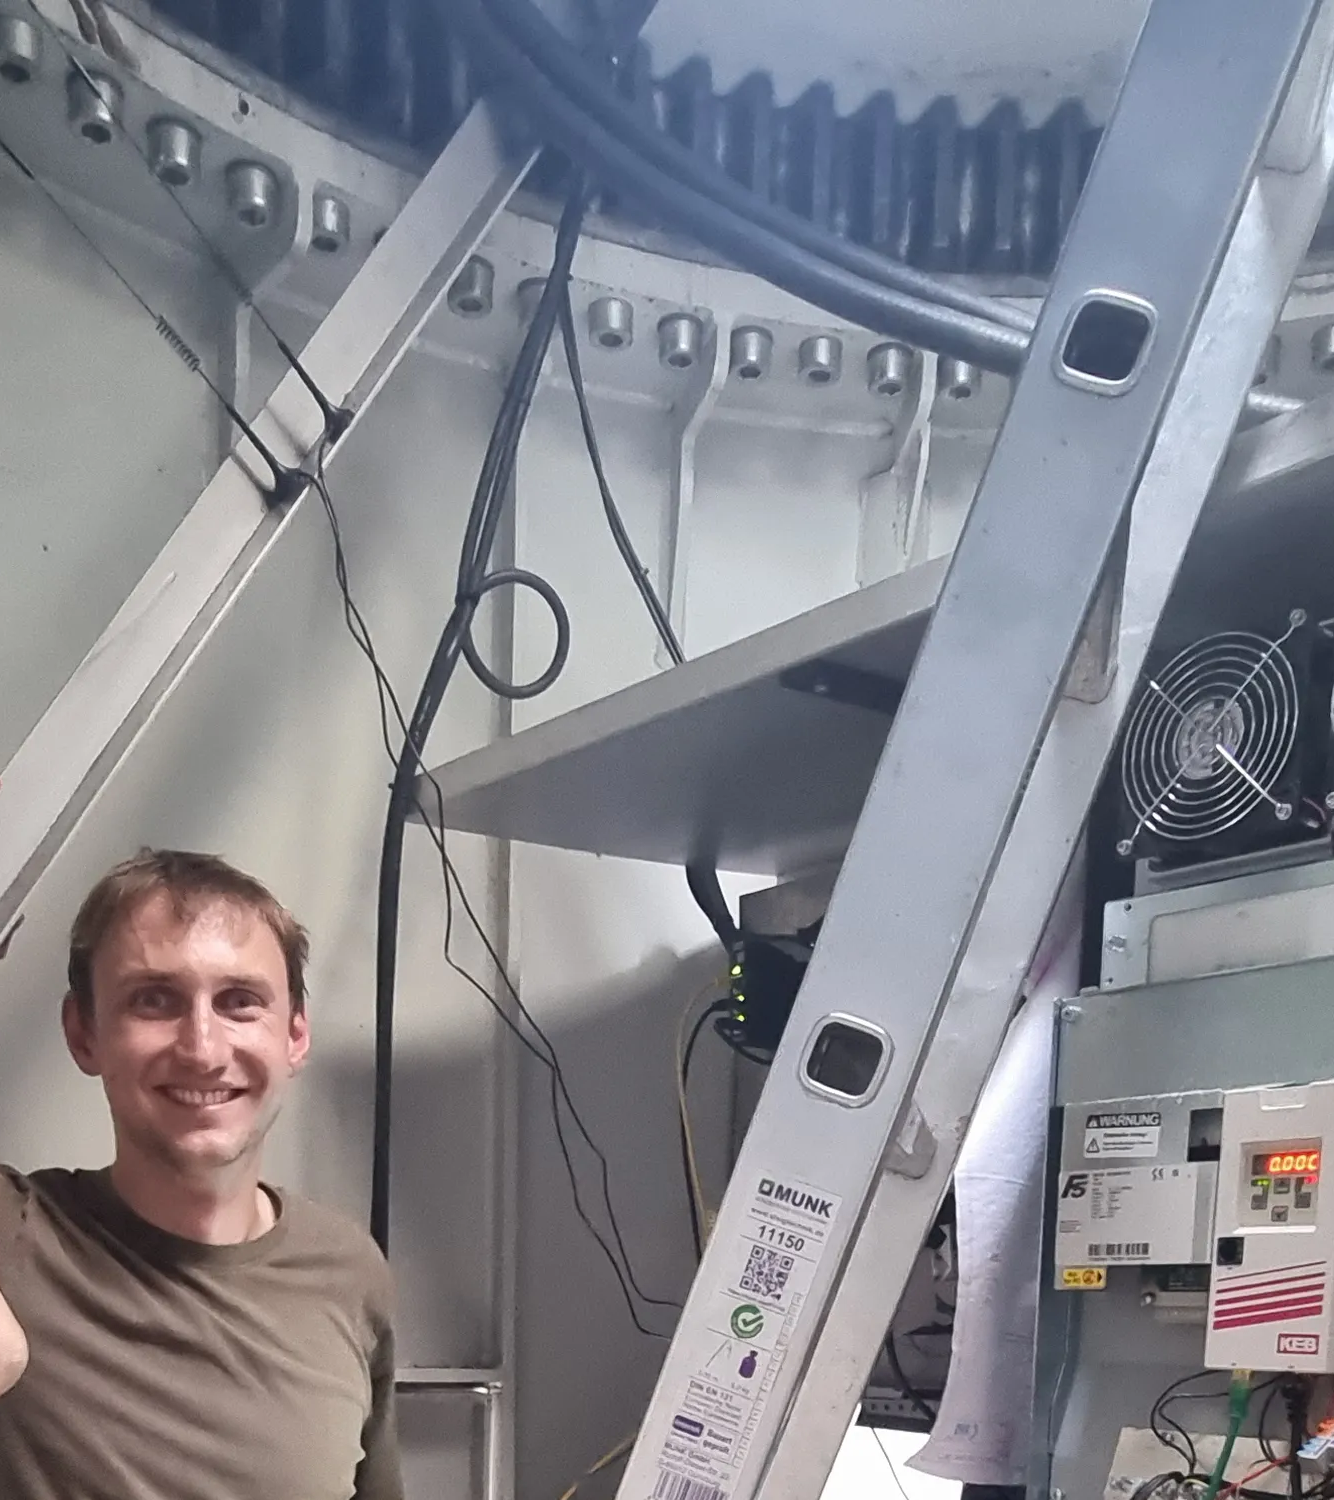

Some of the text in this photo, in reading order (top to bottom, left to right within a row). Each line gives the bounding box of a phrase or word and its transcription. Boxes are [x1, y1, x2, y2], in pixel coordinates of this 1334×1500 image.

[1099, 1113, 1160, 1127] WARNUNG
[1061, 1173, 1089, 1199] F5
[774, 1184, 834, 1218] MUNK
[758, 1225, 805, 1252] 11150
[1279, 1336, 1318, 1353] KEB
